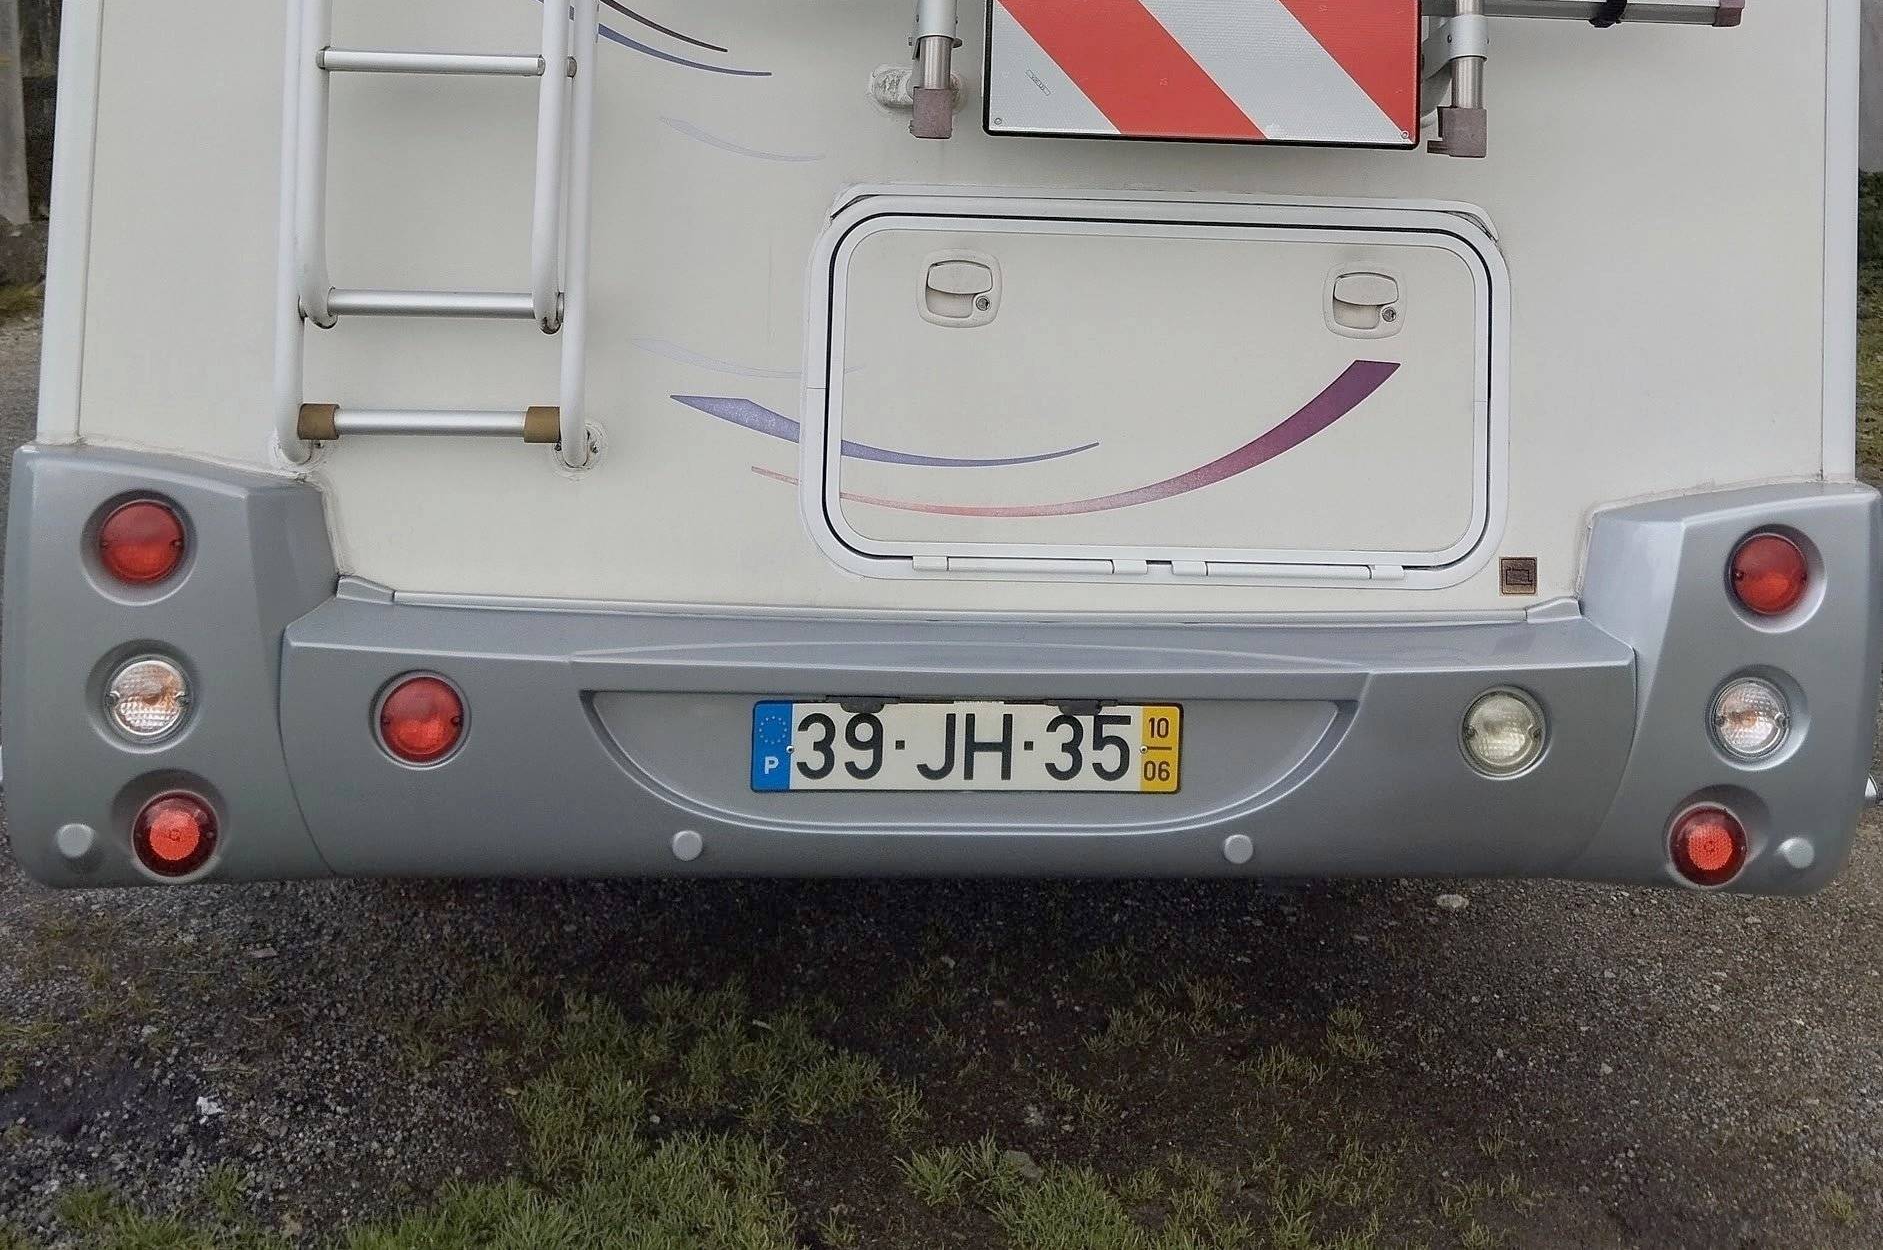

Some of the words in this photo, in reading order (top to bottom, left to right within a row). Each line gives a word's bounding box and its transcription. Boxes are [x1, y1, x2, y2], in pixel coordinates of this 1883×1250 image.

[1148, 717, 1170, 739] 10
[763, 755, 780, 775] P
[1143, 760, 1171, 782] 06
